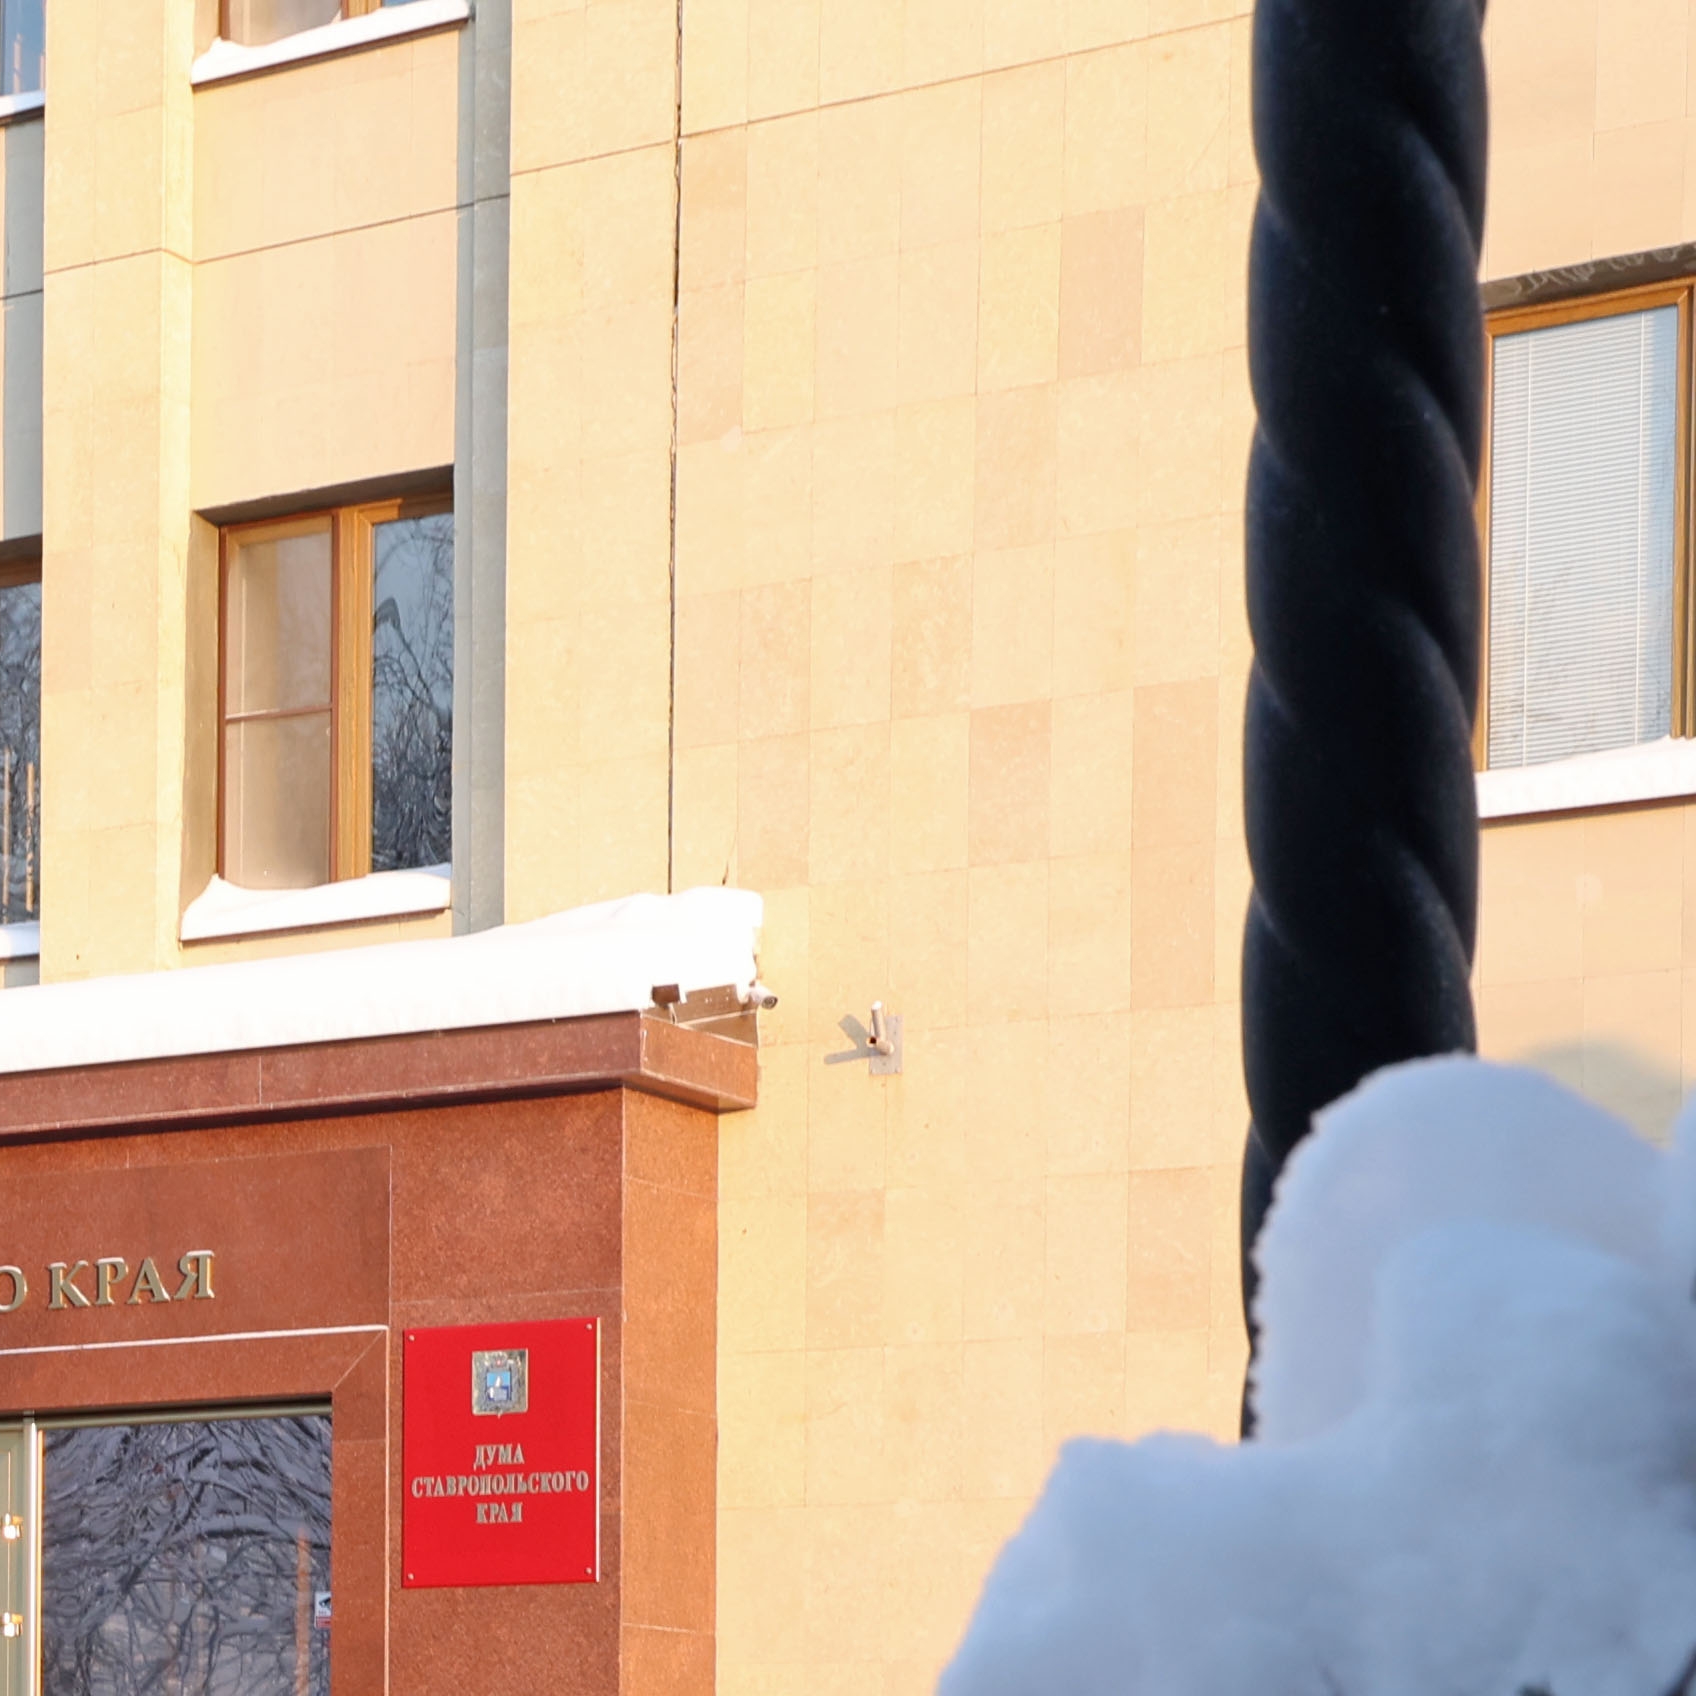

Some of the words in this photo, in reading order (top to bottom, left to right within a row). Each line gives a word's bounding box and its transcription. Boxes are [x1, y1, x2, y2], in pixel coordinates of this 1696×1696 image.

[49, 1250, 216, 1311] КРАЯ
[474, 1444, 525, 1471] ДУМА
[411, 1471, 590, 1498] СТАВРОПОЛЬСКОГО
[476, 1502, 523, 1523] КРАЯ
